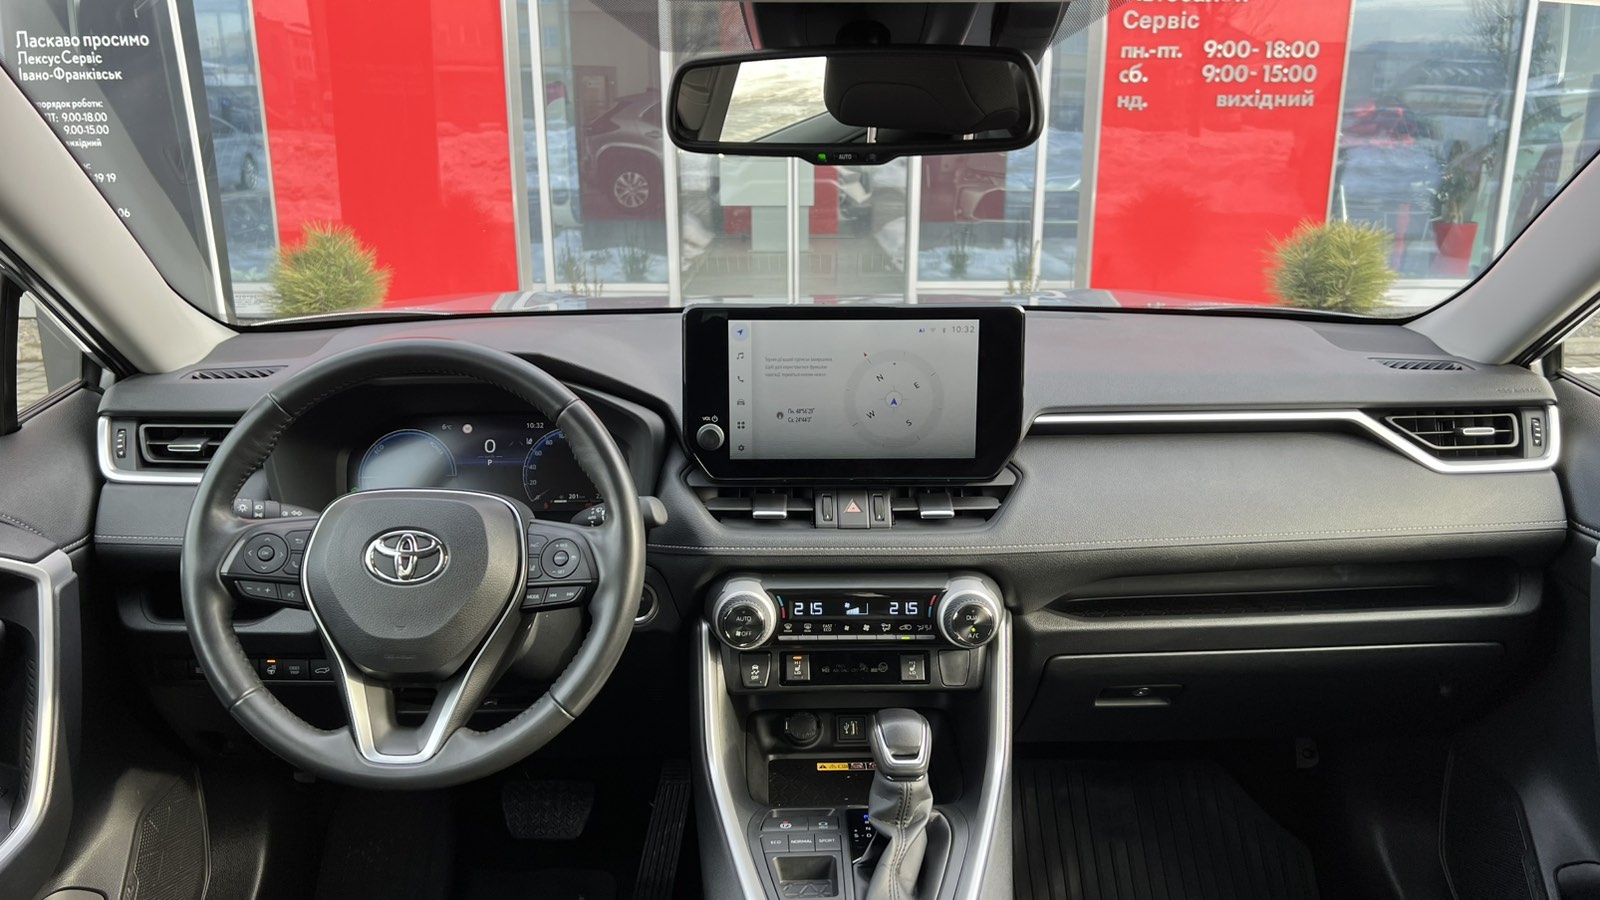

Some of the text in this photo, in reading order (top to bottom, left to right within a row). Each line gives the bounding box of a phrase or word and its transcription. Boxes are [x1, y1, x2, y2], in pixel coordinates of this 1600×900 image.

[1122, 10, 1200, 33] Сервіс
[16, 31, 150, 50] Ласкаво просимо
[1120, 46, 1183, 59] пн.-пт.
[1265, 40, 1320, 58] 18:00
[18, 67, 123, 83] Івано-Франківськ
[1118, 64, 1149, 83] сб.
[1263, 64, 1317, 83] 15:00
[1117, 89, 1315, 111] нд. вихідний
[106, 173, 117, 183] 19
[951, 325, 975, 334] 10:32
[876, 372, 884, 383] N
[913, 381, 921, 389] E
[866, 409, 876, 420] W
[905, 418, 913, 427] S
[484, 438, 496, 453] 0
